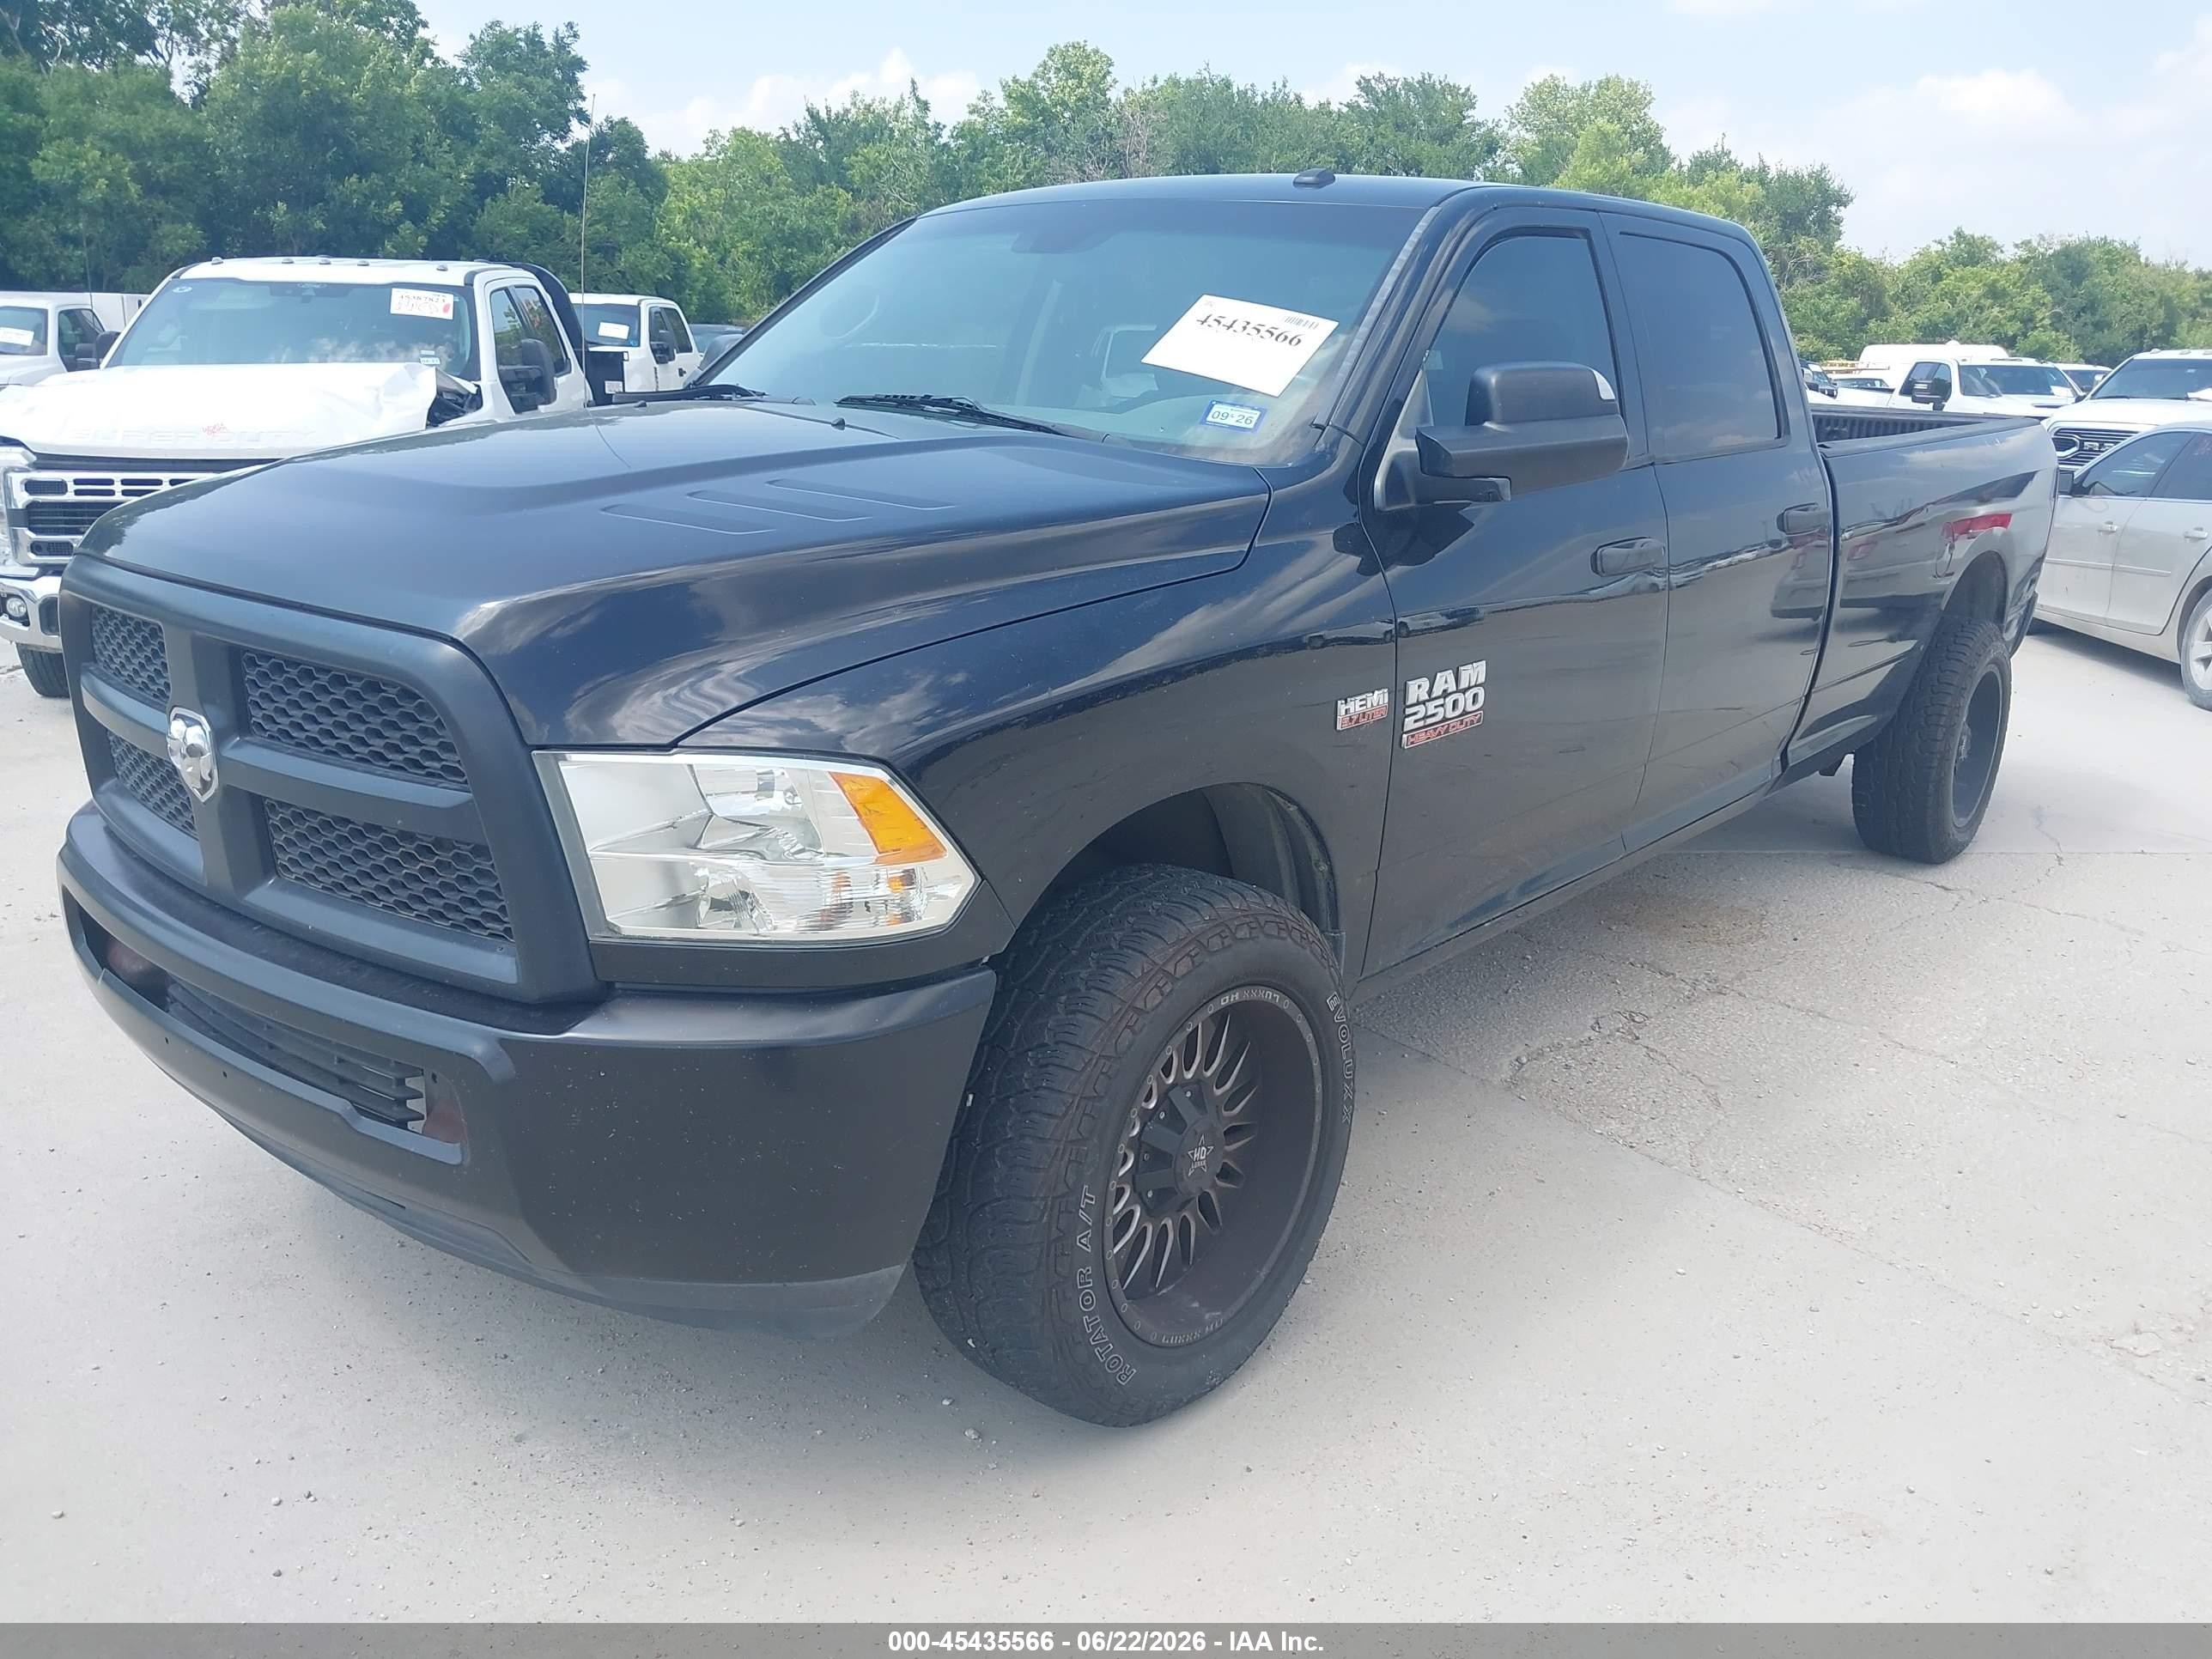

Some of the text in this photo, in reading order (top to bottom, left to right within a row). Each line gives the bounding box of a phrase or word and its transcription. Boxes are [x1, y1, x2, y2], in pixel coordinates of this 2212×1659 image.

[1196, 313, 1305, 346] 45435566
[1211, 410, 1230, 421] 09
[1235, 414, 1255, 425] 26
[1405, 659, 1486, 705] RAM
[1336, 689, 1389, 716] HEMI
[1359, 706, 1388, 724] LITER
[1403, 687, 1486, 732] 2500
[1407, 714, 1481, 745] HEAVY DUTY
[1326, 991, 1353, 1124] EVOLUXX
[1193, 1146, 1206, 1162] HD
[1077, 1184, 1136, 1385] ROTATOR A/T
